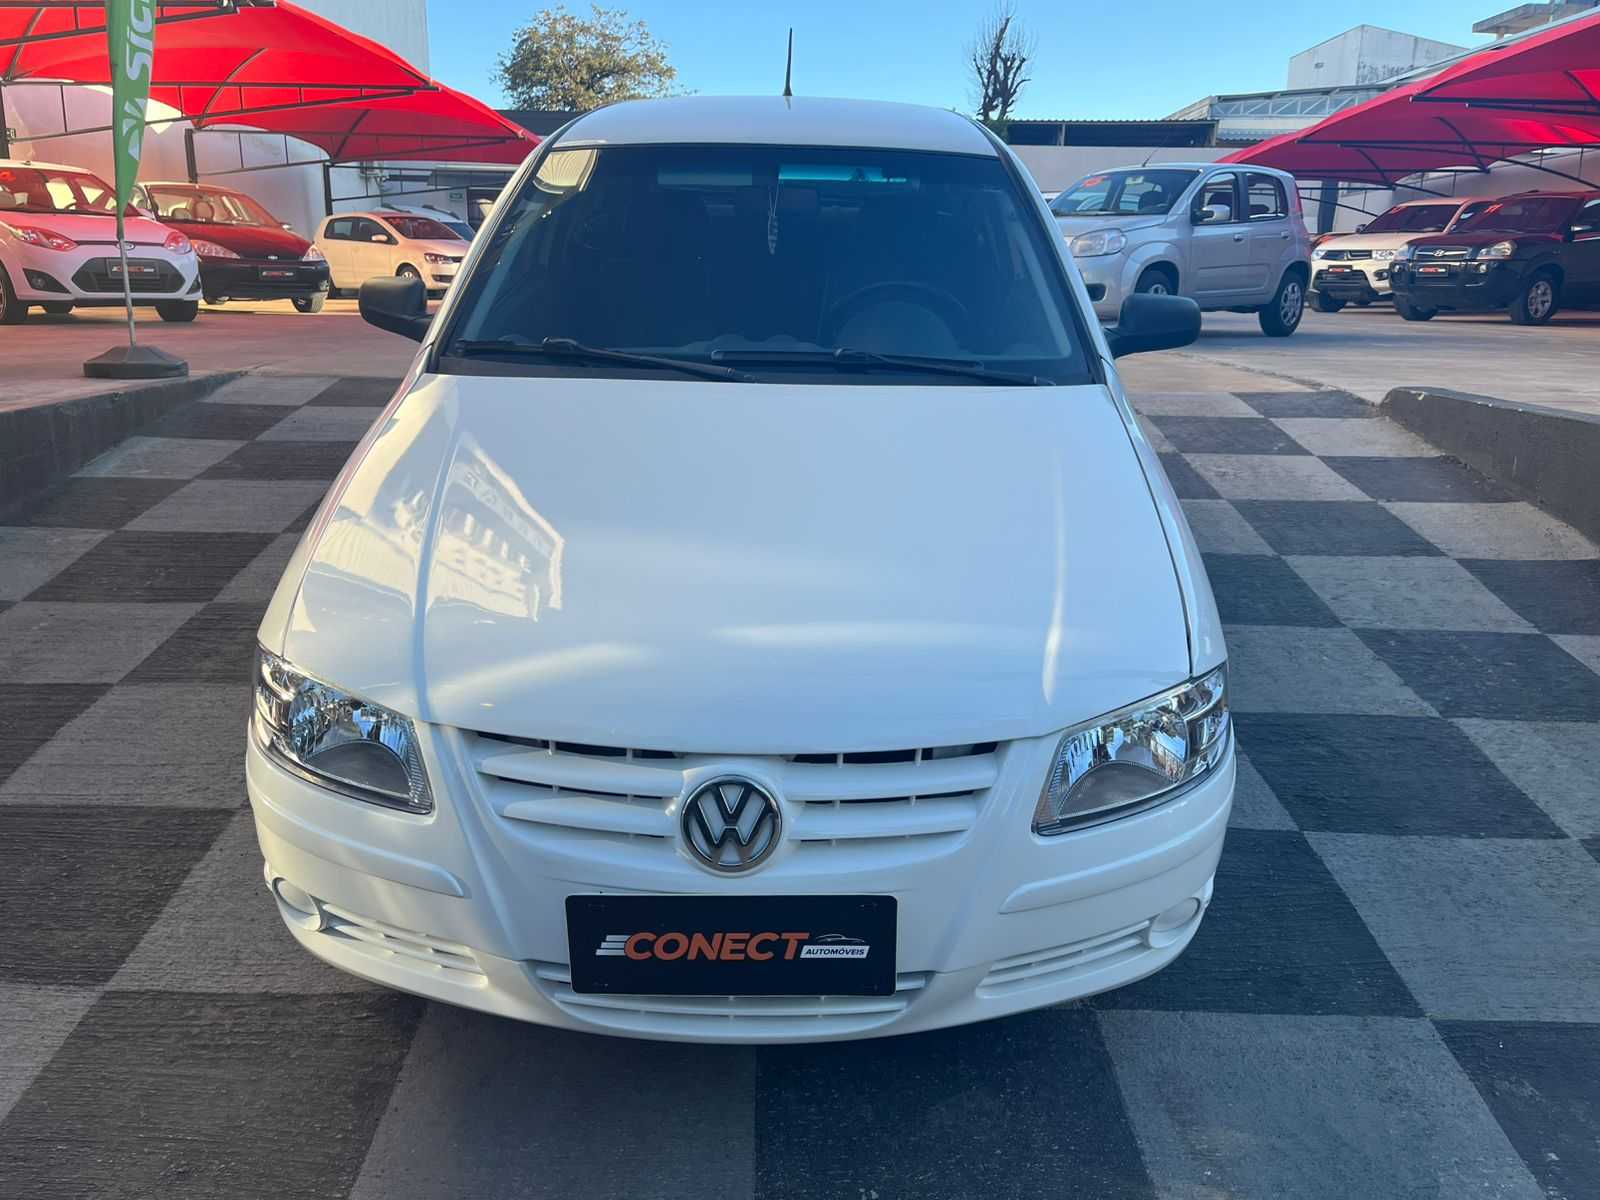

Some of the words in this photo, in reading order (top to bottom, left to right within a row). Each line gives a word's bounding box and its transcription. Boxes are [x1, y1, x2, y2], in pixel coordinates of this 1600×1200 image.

[683, 780, 779, 867] VW
[624, 932, 810, 961] CONECT
[804, 945, 866, 956] AUTOMÓVEIS
